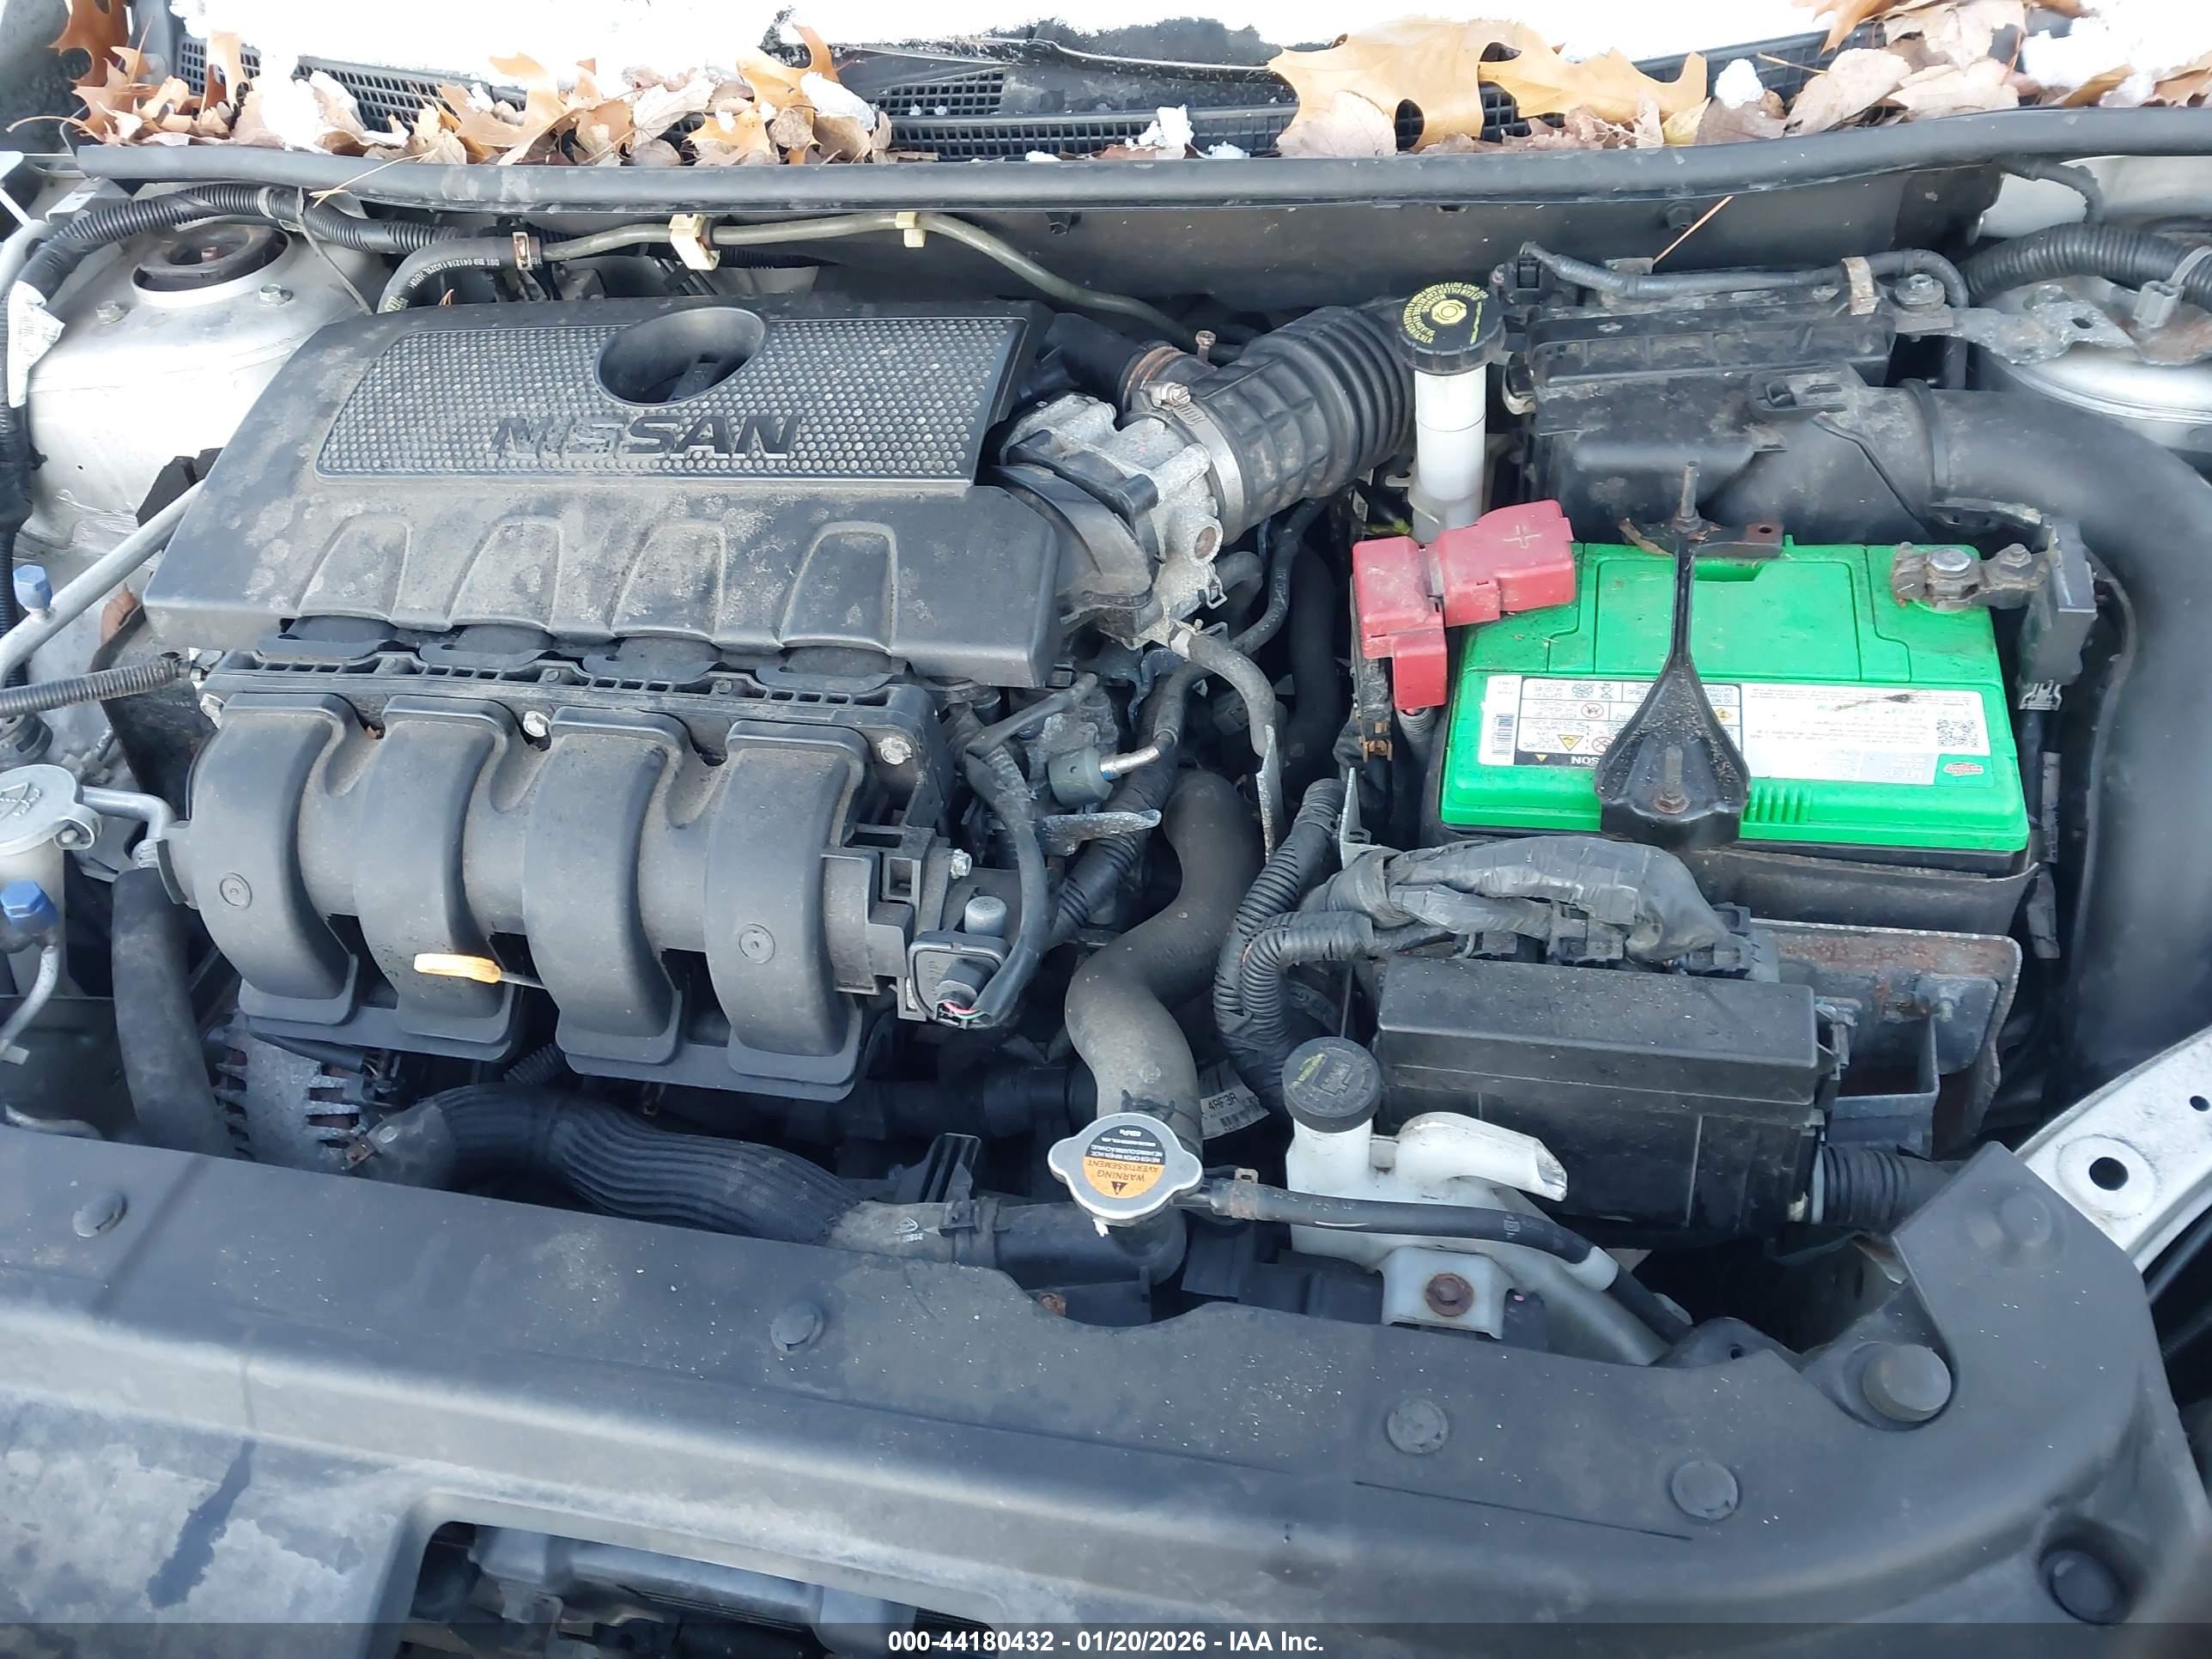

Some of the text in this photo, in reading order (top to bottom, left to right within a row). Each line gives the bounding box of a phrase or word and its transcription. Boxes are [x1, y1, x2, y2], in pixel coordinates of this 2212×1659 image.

[487, 416, 801, 459] NISSAN
[1086, 1159, 1158, 1172] AVERTISSEMENT
[1097, 1170, 1145, 1182] WARNING
